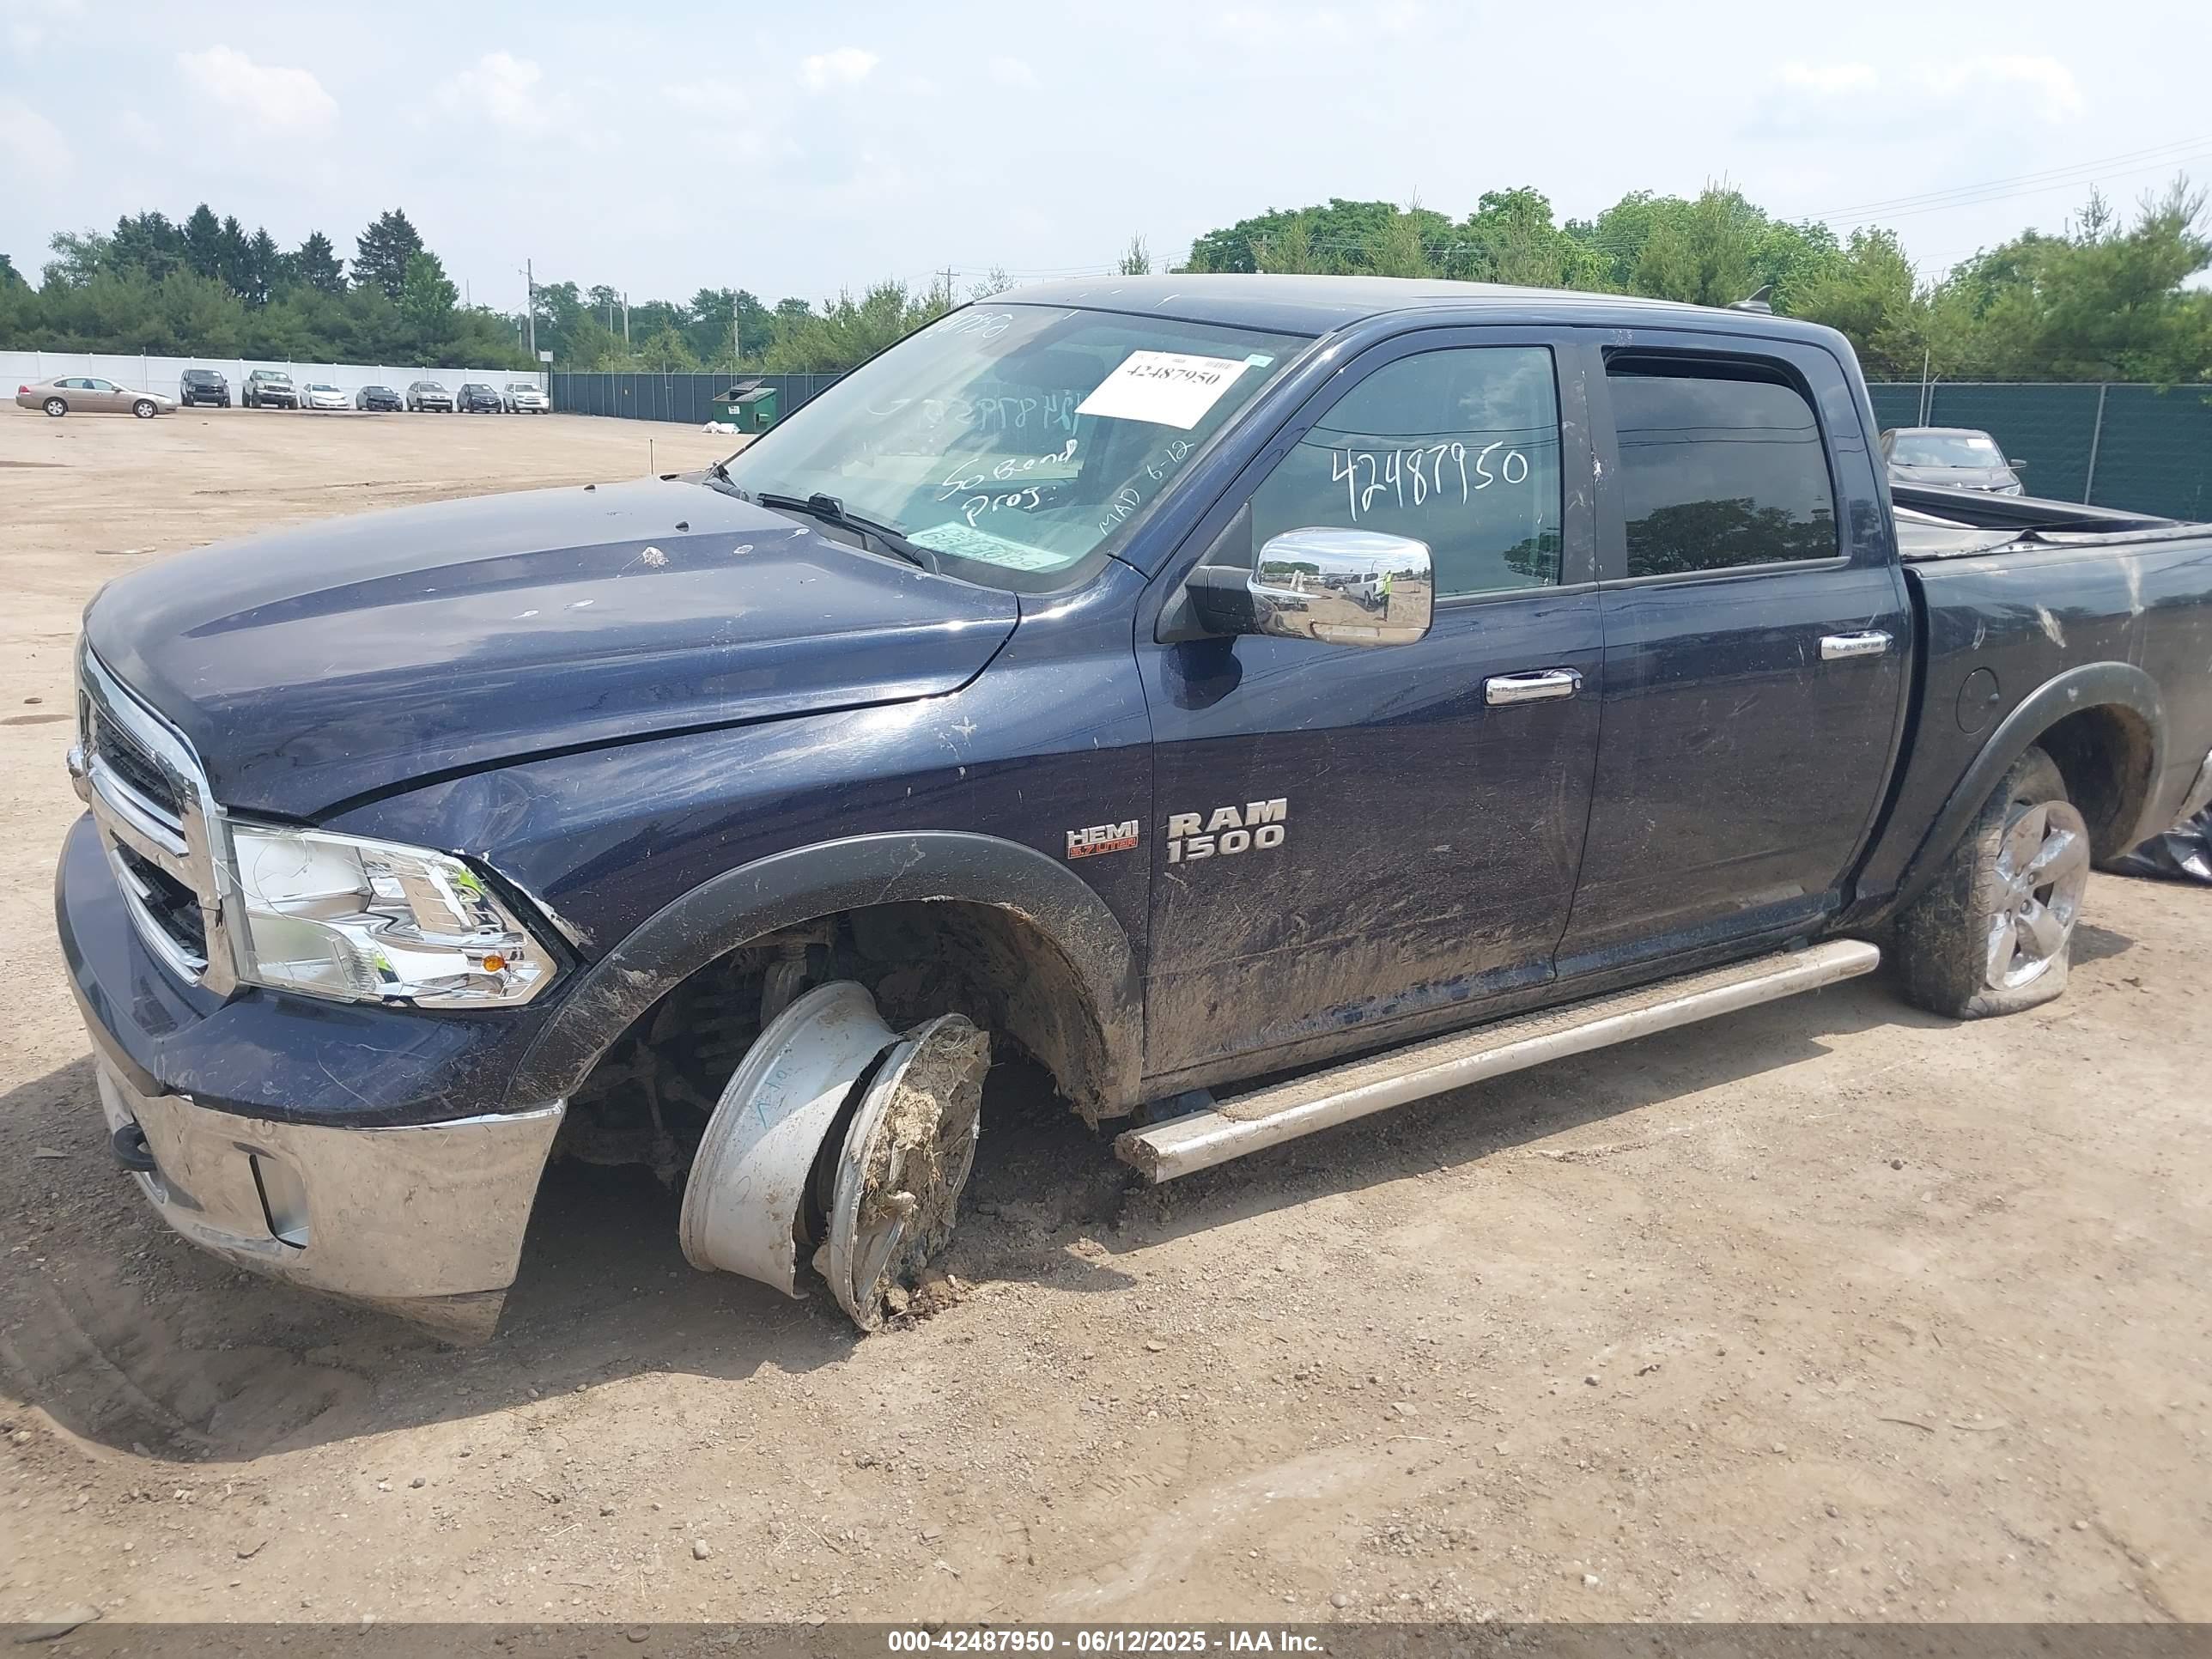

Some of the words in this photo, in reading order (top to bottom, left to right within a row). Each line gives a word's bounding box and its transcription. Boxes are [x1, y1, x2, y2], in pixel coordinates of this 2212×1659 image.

[1127, 364, 1221, 386] 42487950
[993, 439, 1079, 480] Bend
[1099, 488, 1140, 536] MAD
[1146, 440, 1195, 480] 6-12
[1332, 441, 1528, 522] 42487950
[1066, 819, 1139, 847] HEMI
[1168, 797, 1288, 839] RAM
[1070, 845, 1095, 858] 5.7
[1167, 824, 1285, 864] 1500
